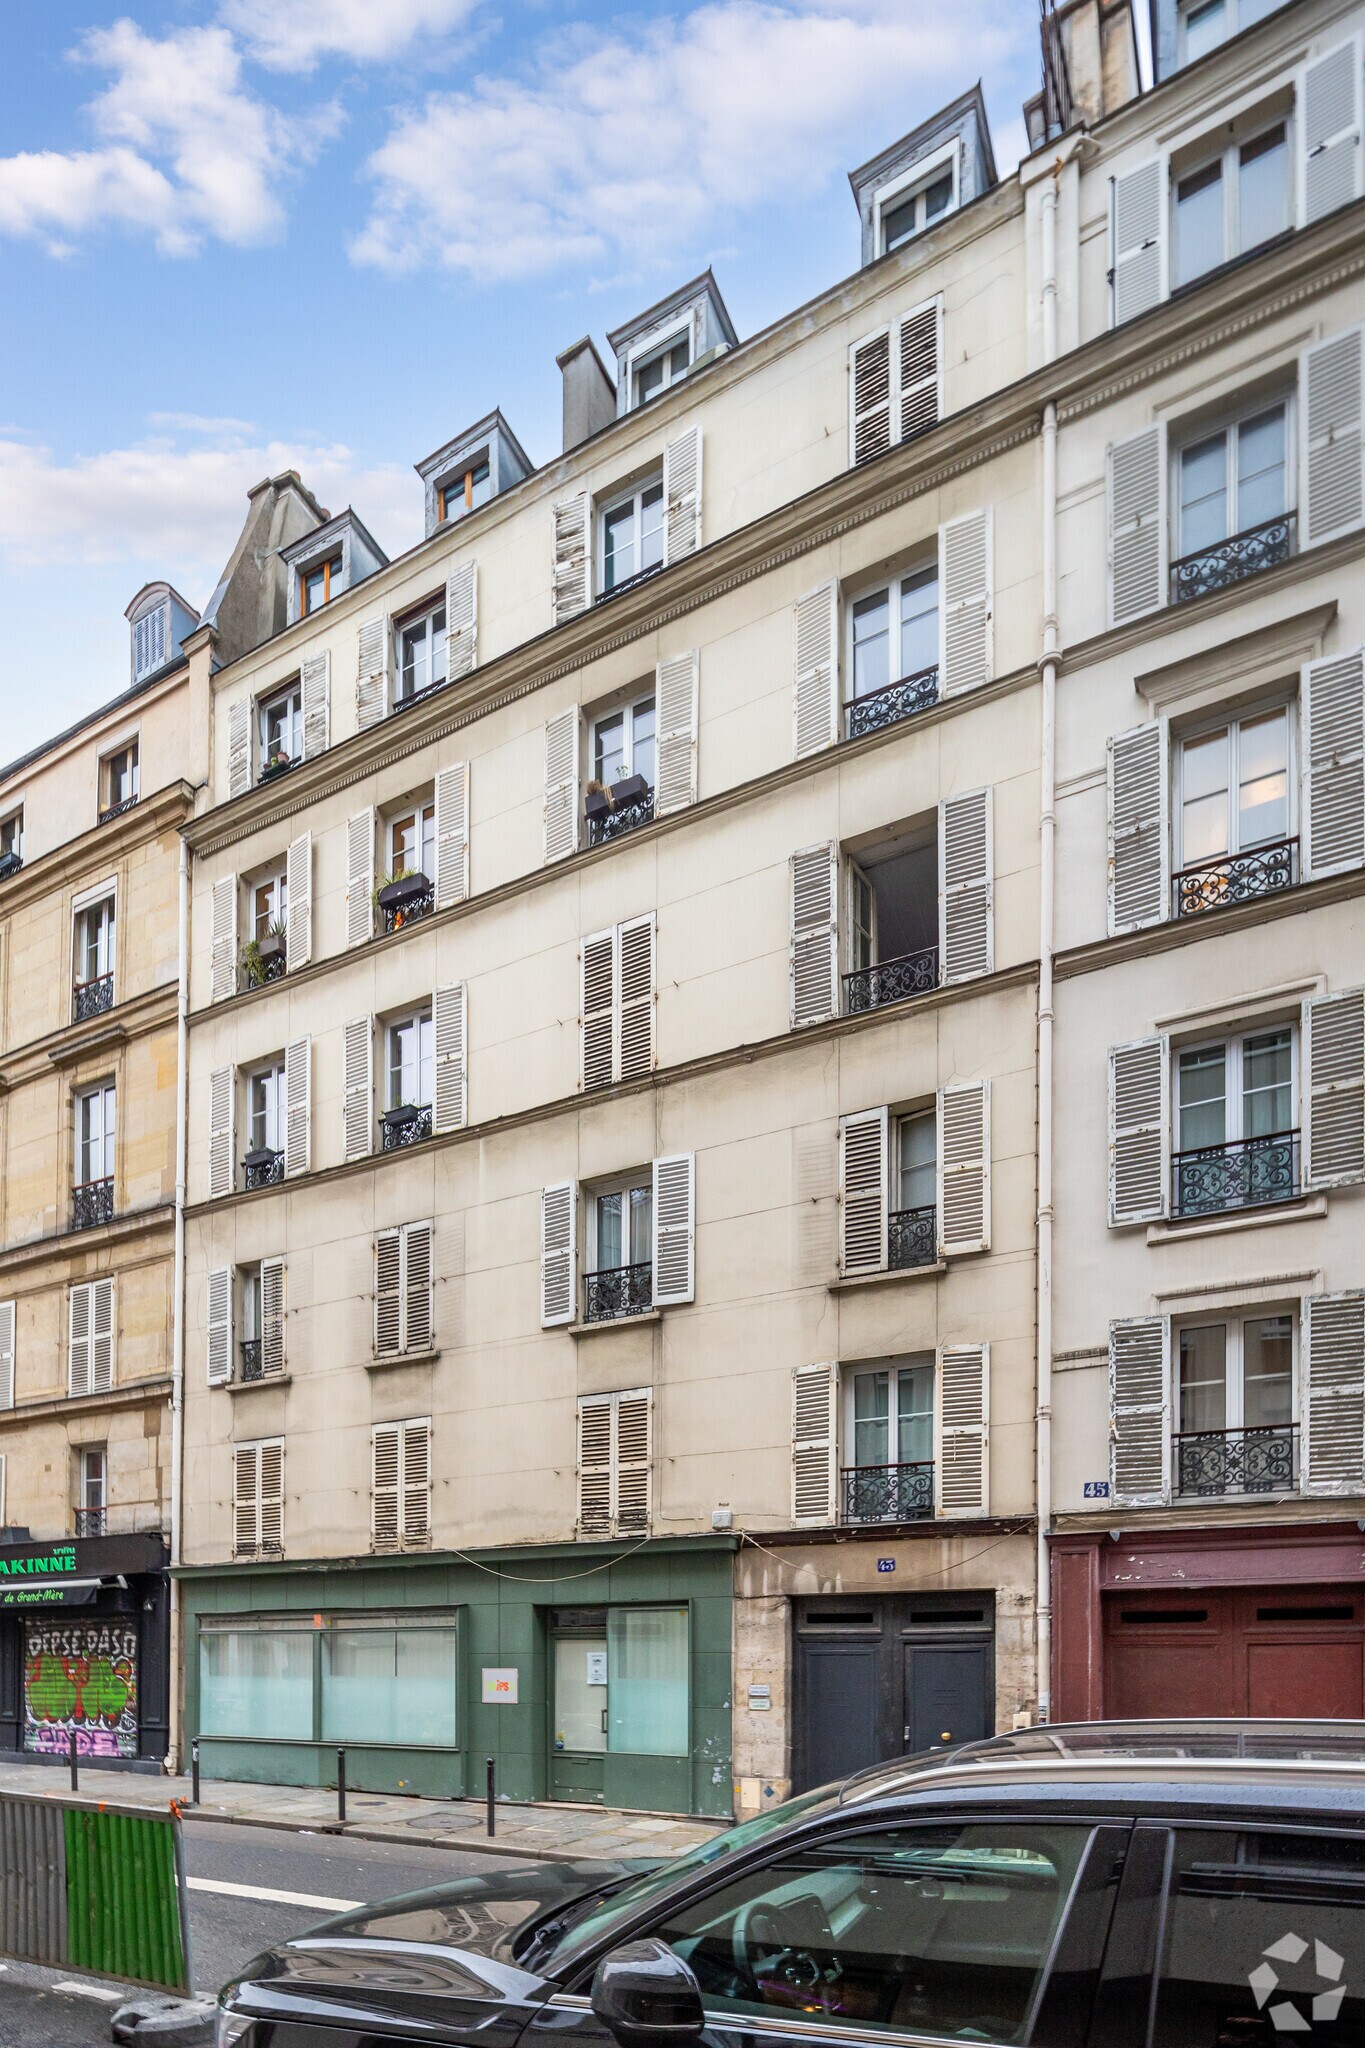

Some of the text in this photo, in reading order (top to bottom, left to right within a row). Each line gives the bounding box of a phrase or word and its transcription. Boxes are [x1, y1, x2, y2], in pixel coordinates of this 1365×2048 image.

[1085, 1483, 1106, 1497] 45
[4, 1589, 64, 1603] de Grand-Mère
